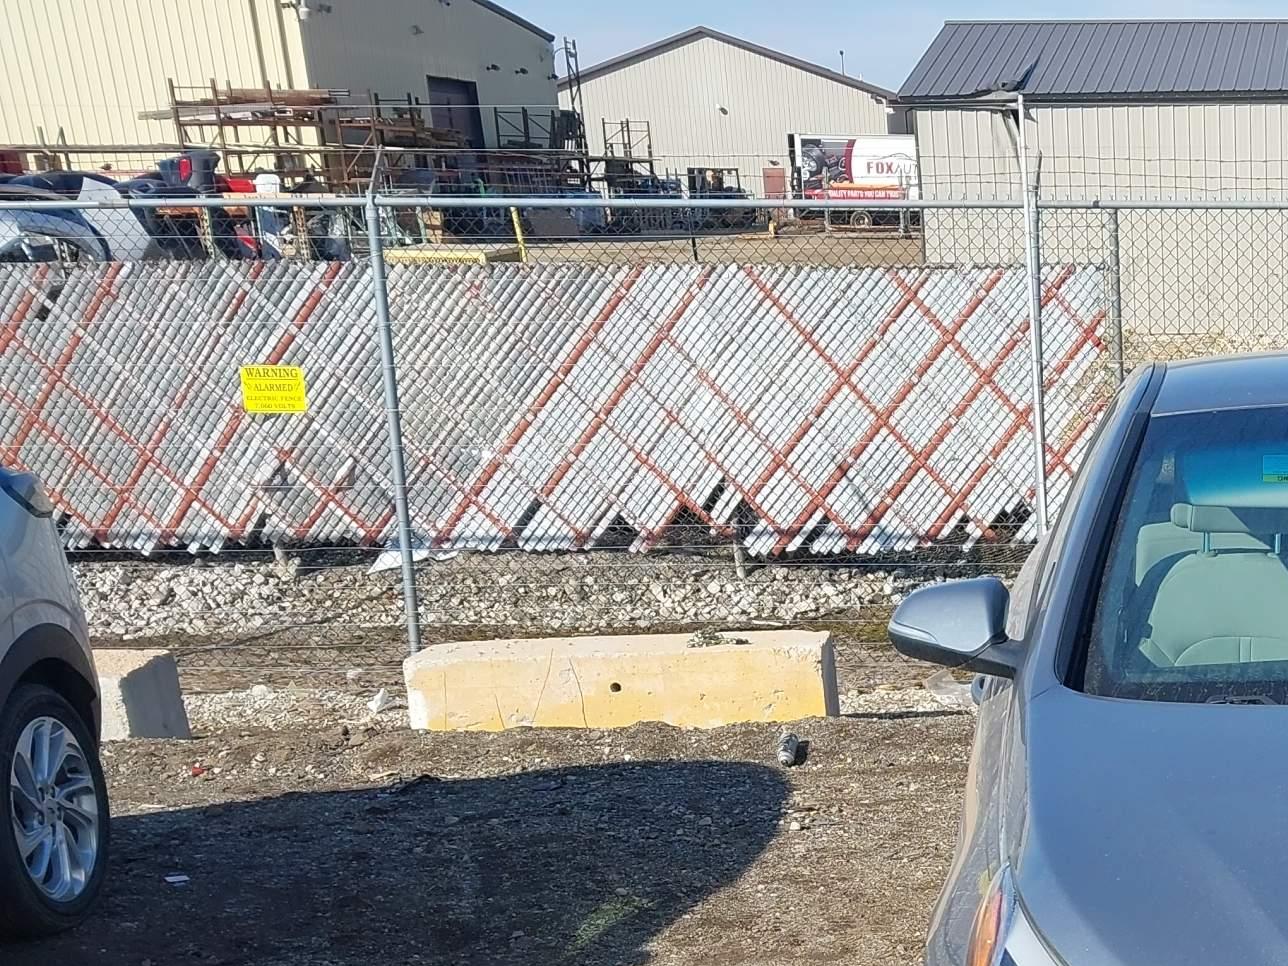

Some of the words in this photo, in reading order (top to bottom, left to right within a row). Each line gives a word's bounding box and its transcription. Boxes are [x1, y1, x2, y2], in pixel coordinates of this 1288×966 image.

[875, 190, 886, 198] CAN
[245, 367, 298, 378] WARNING
[254, 383, 293, 392] ALARMED
